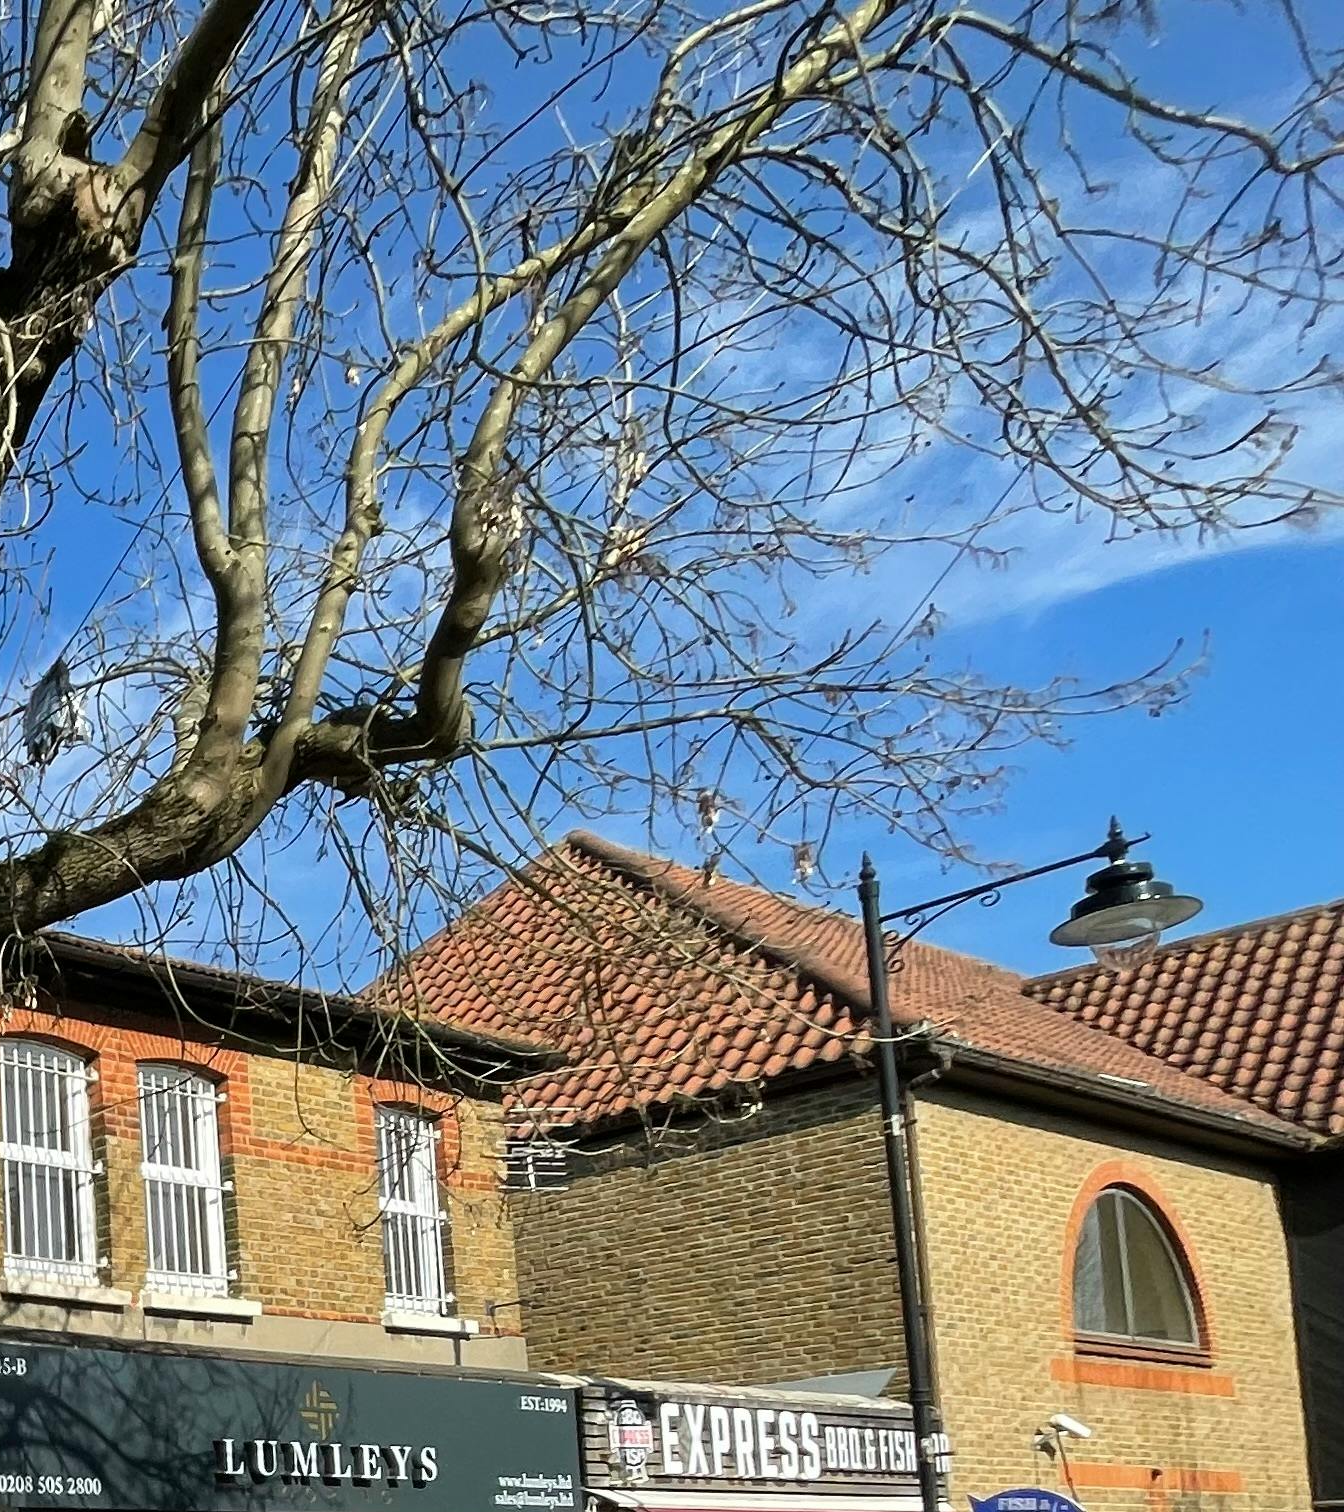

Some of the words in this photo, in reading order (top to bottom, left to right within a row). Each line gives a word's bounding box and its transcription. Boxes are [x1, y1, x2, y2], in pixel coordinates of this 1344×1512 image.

[520, 1395, 568, 1413] EST:1994
[660, 1402, 821, 1480] EXPRESS
[825, 1426, 863, 1469] BBQ
[864, 1428, 877, 1470] &
[878, 1429, 918, 1472] FISH
[223, 1438, 439, 1482] LUMLEYS
[37, 1476, 64, 1495] 505
[66, 1477, 102, 1496] 2800
